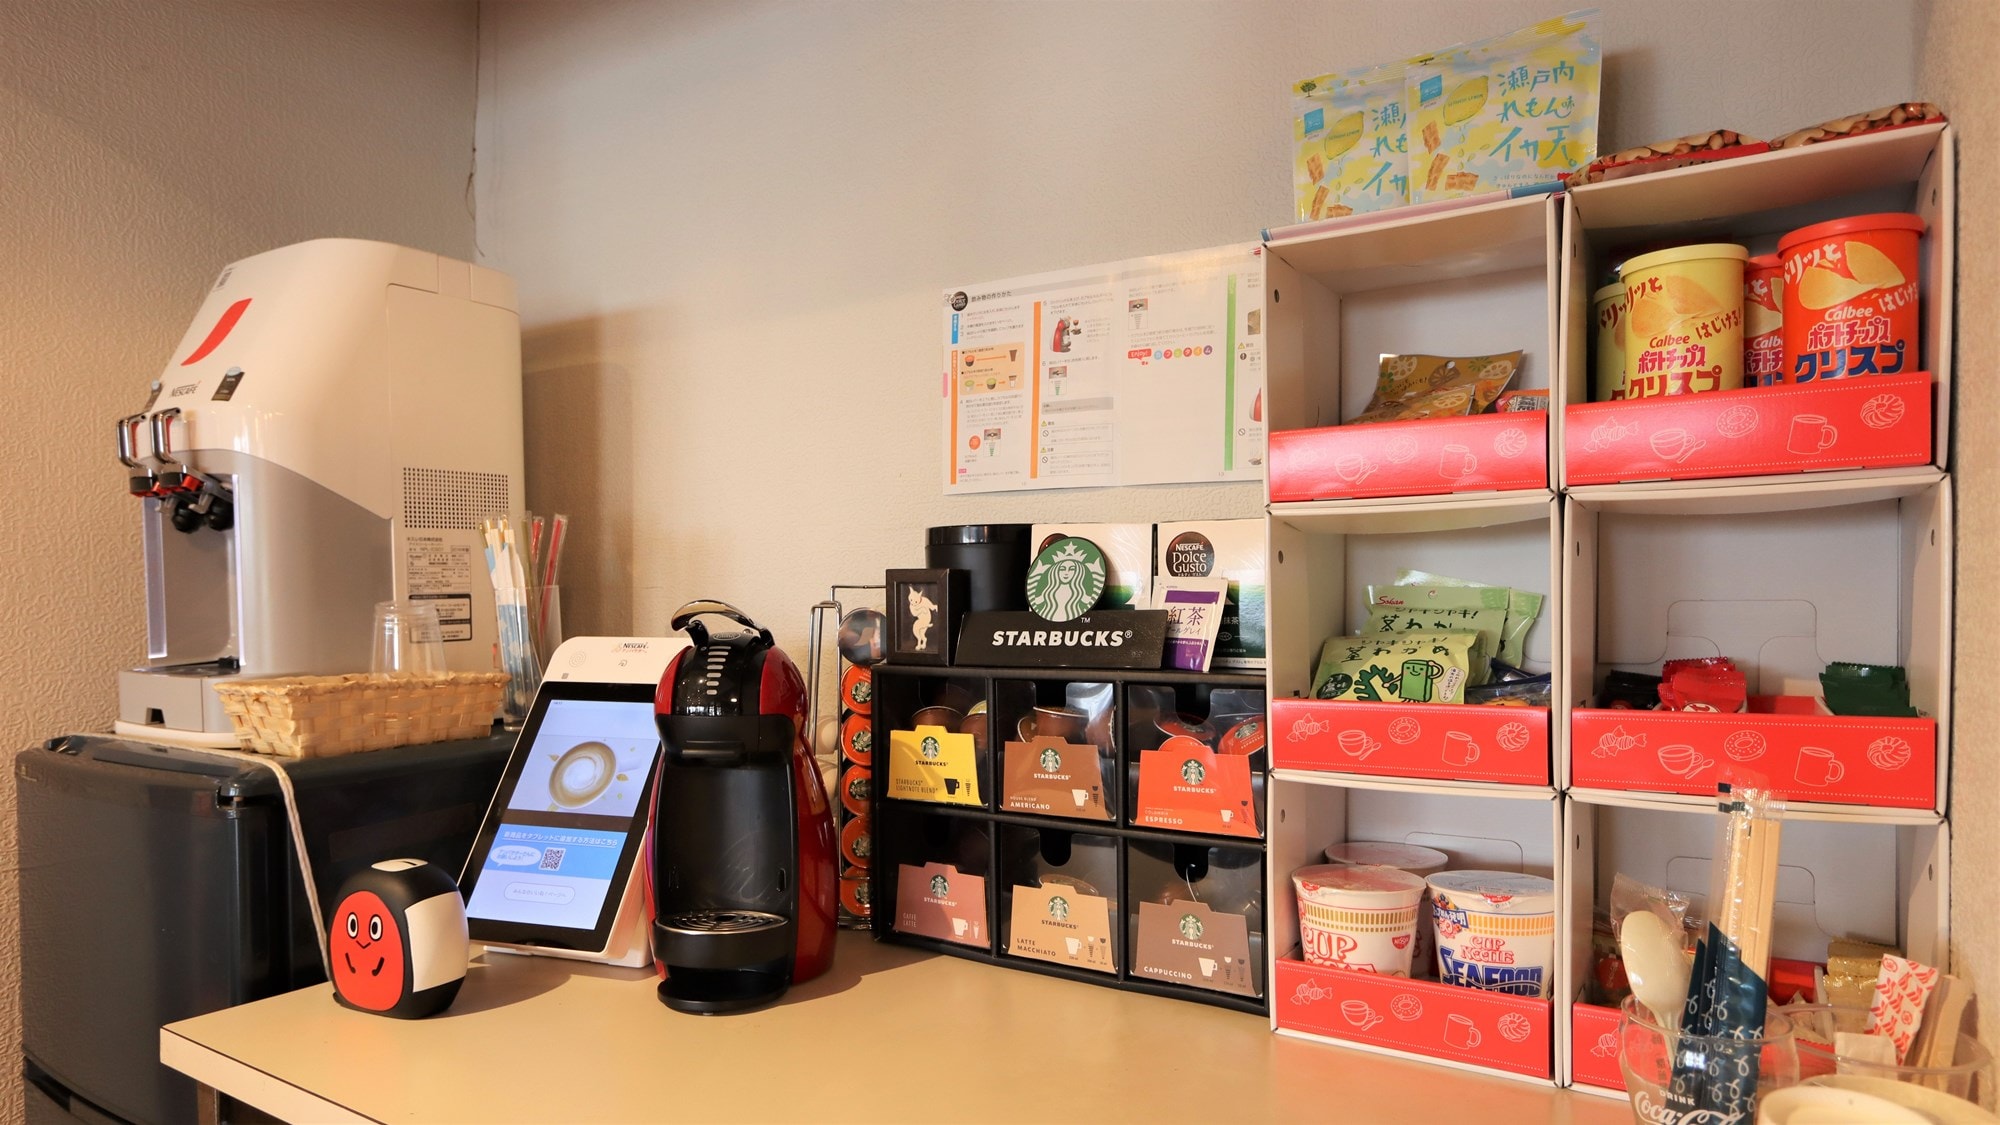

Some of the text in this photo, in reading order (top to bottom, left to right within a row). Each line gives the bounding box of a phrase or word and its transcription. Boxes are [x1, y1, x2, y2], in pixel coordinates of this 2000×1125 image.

[1496, 60, 1575, 97] 瀬戸内
[1370, 133, 1408, 158] れも
[1362, 161, 1407, 196] イカ
[1625, 276, 1663, 312] リッと
[1824, 306, 1874, 322] Calbee
[1649, 334, 1691, 349] Calbee
[1807, 316, 1892, 352] ポテトチップス
[1637, 343, 1706, 375] ポテトチップス
[1795, 338, 1906, 383] クリスプ
[1628, 364, 1723, 399] クリスプ
[1172, 551, 1207, 563] Dolce
[1173, 563, 1207, 574] Gusto
[1168, 606, 1206, 626] 紅茶
[1010, 802, 1050, 810] AMERICANO
[1145, 816, 1183, 825] ESPRESSO
[903, 920, 917, 928] LATTE
[1017, 938, 1036, 946] LATTE
[1017, 945, 1056, 957] MACCHIATO
[1301, 923, 1358, 964] CUP
[1471, 935, 1506, 951] CUP
[1460, 945, 1515, 965] NOODLE
[1143, 966, 1192, 980] CAPPUCCINO
[1440, 945, 1543, 998] SEAFOOD
[1659, 1089, 1695, 1106] DRINK
